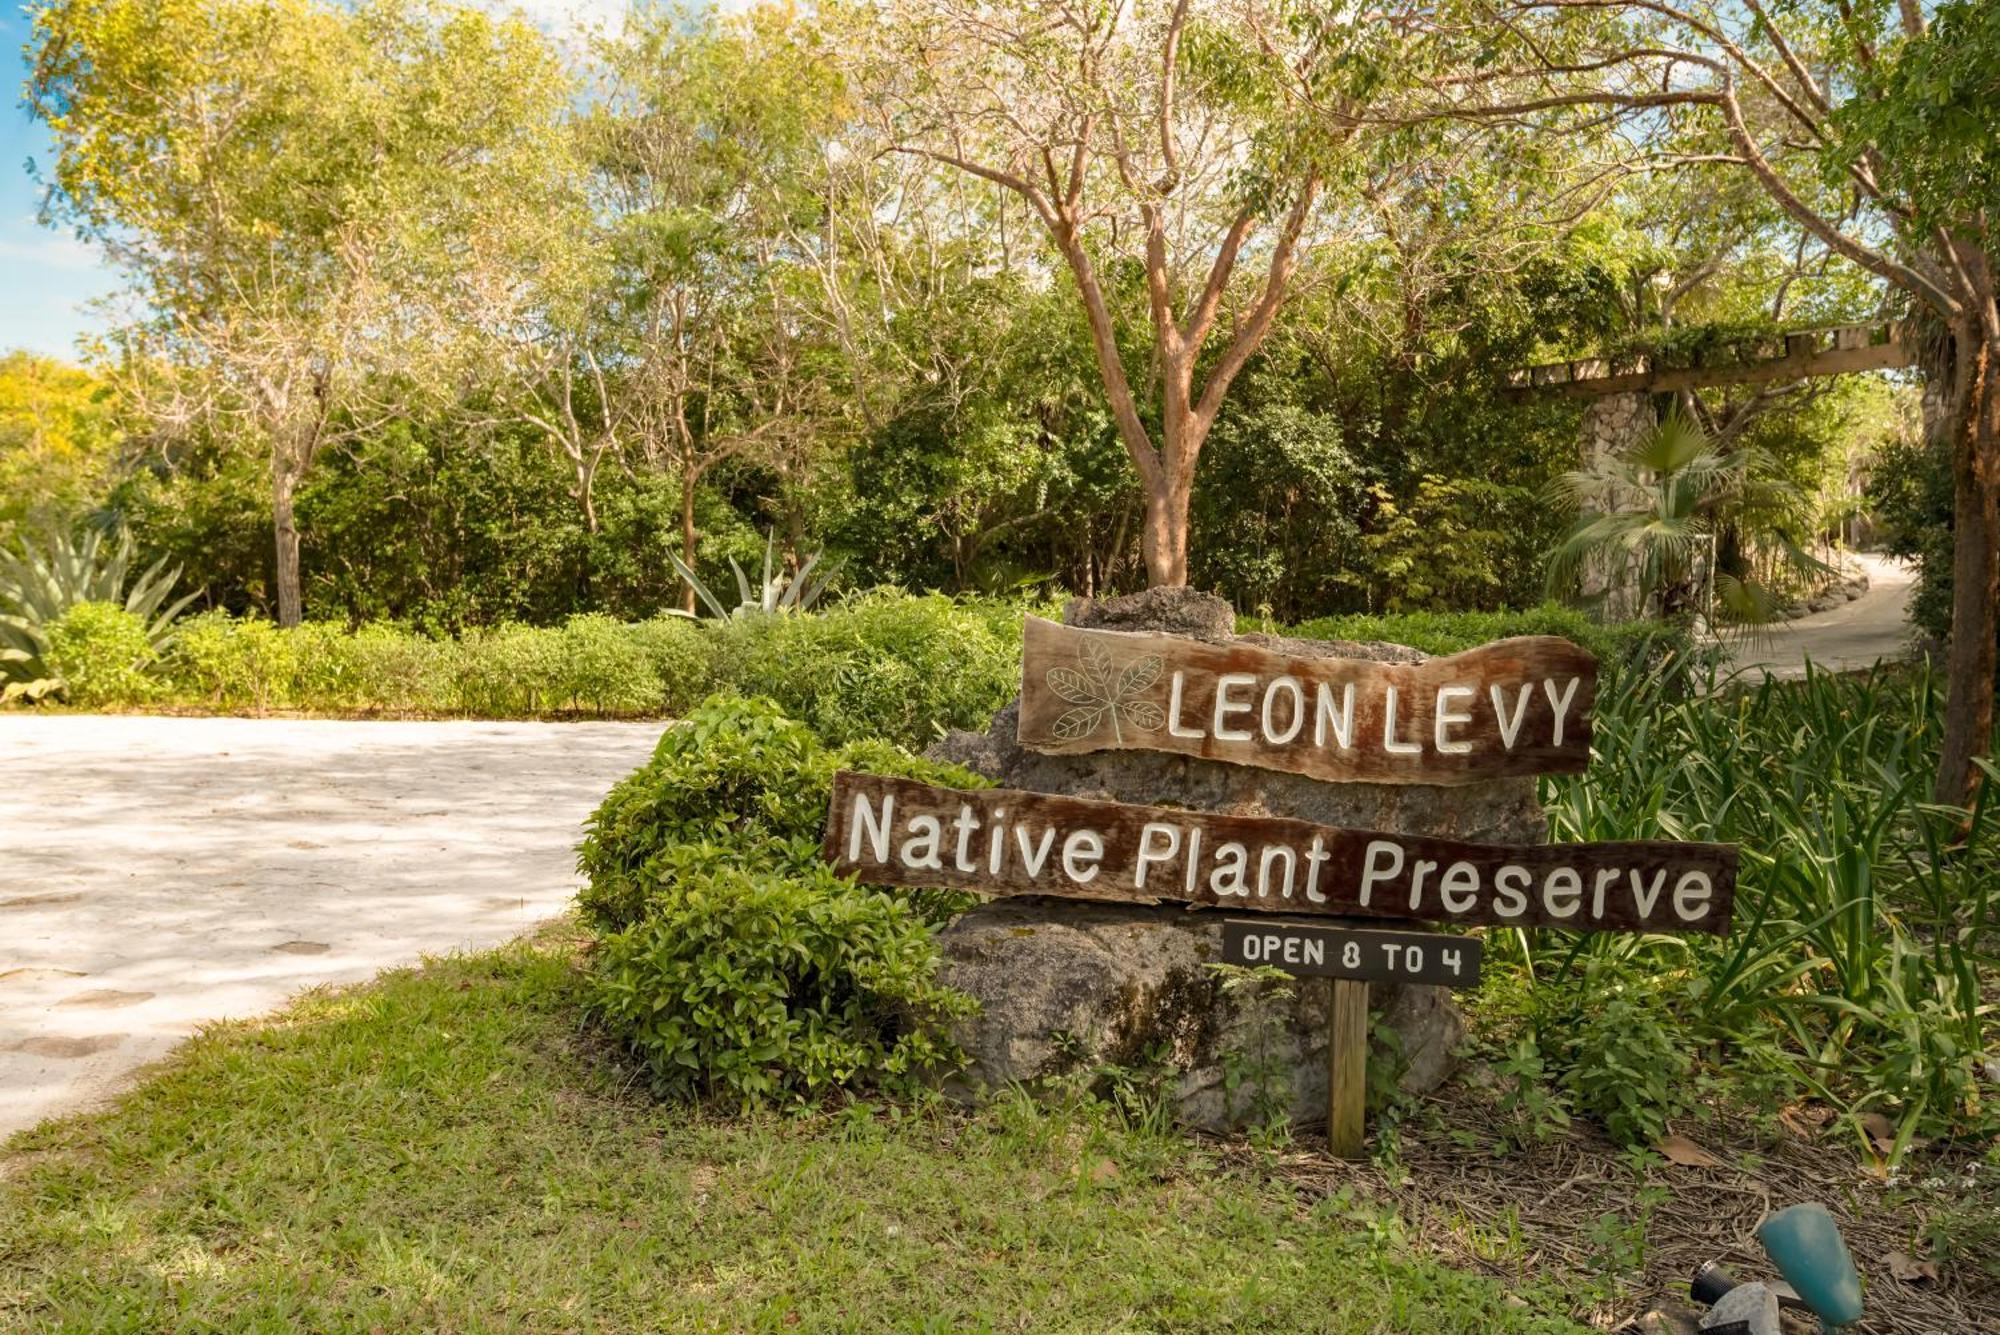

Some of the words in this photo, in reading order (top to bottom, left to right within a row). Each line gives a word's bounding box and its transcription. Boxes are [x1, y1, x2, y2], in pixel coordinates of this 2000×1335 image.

[1168, 670, 1356, 749] LEON
[1384, 676, 1581, 753] LEVY
[848, 793, 1104, 883] Native
[1134, 822, 1331, 903] Plant
[1359, 840, 1713, 922] Preserve
[1243, 934, 1324, 966] OPEN
[1342, 941, 1361, 969] 8
[1381, 943, 1423, 973] TO
[1442, 948, 1462, 976] 4
